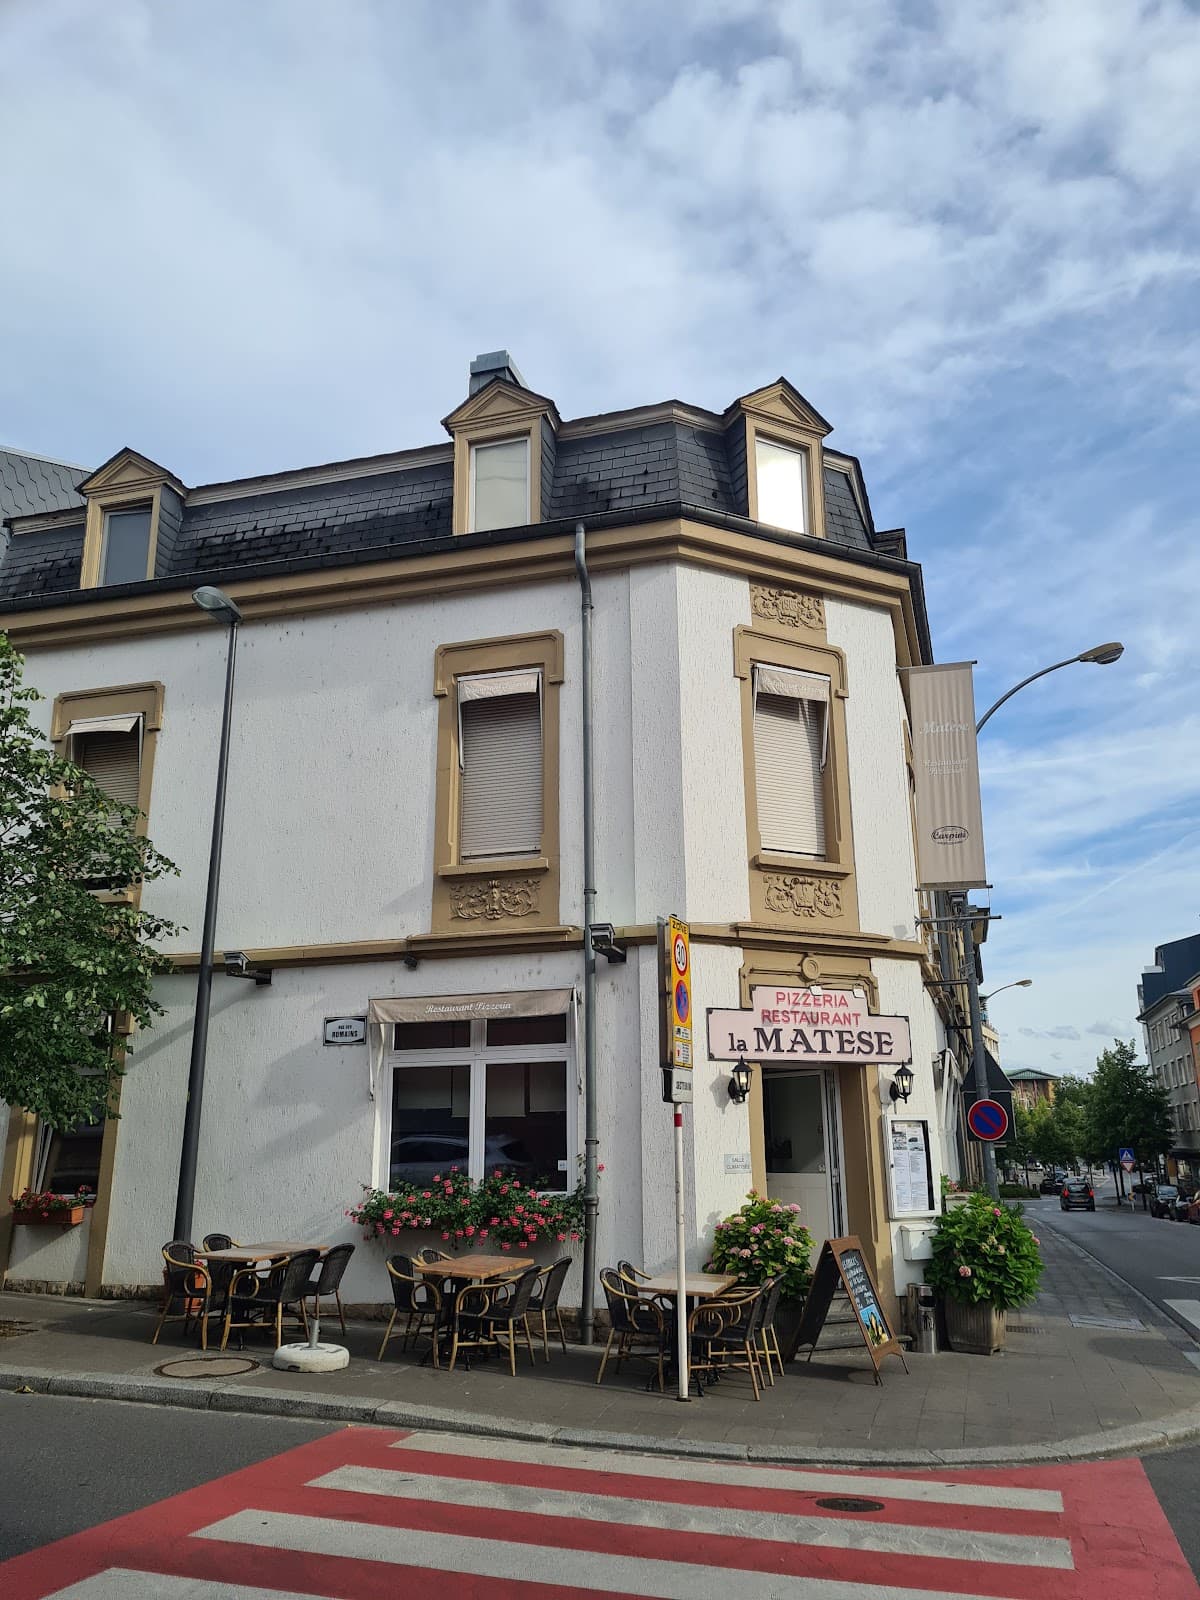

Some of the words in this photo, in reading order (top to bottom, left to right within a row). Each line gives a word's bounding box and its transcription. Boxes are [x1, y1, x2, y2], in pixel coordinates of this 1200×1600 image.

[672, 921, 688, 935] ZONE
[676, 944, 685, 966] 30
[425, 1003, 473, 1014] Restaurant
[475, 1001, 512, 1010] Pizzeria
[775, 991, 849, 1008] PIZZERIA
[761, 1009, 861, 1027] RESTAURANT
[331, 1030, 358, 1039] ROMAINS
[728, 1033, 748, 1052] la
[754, 1027, 894, 1056] MATESE
